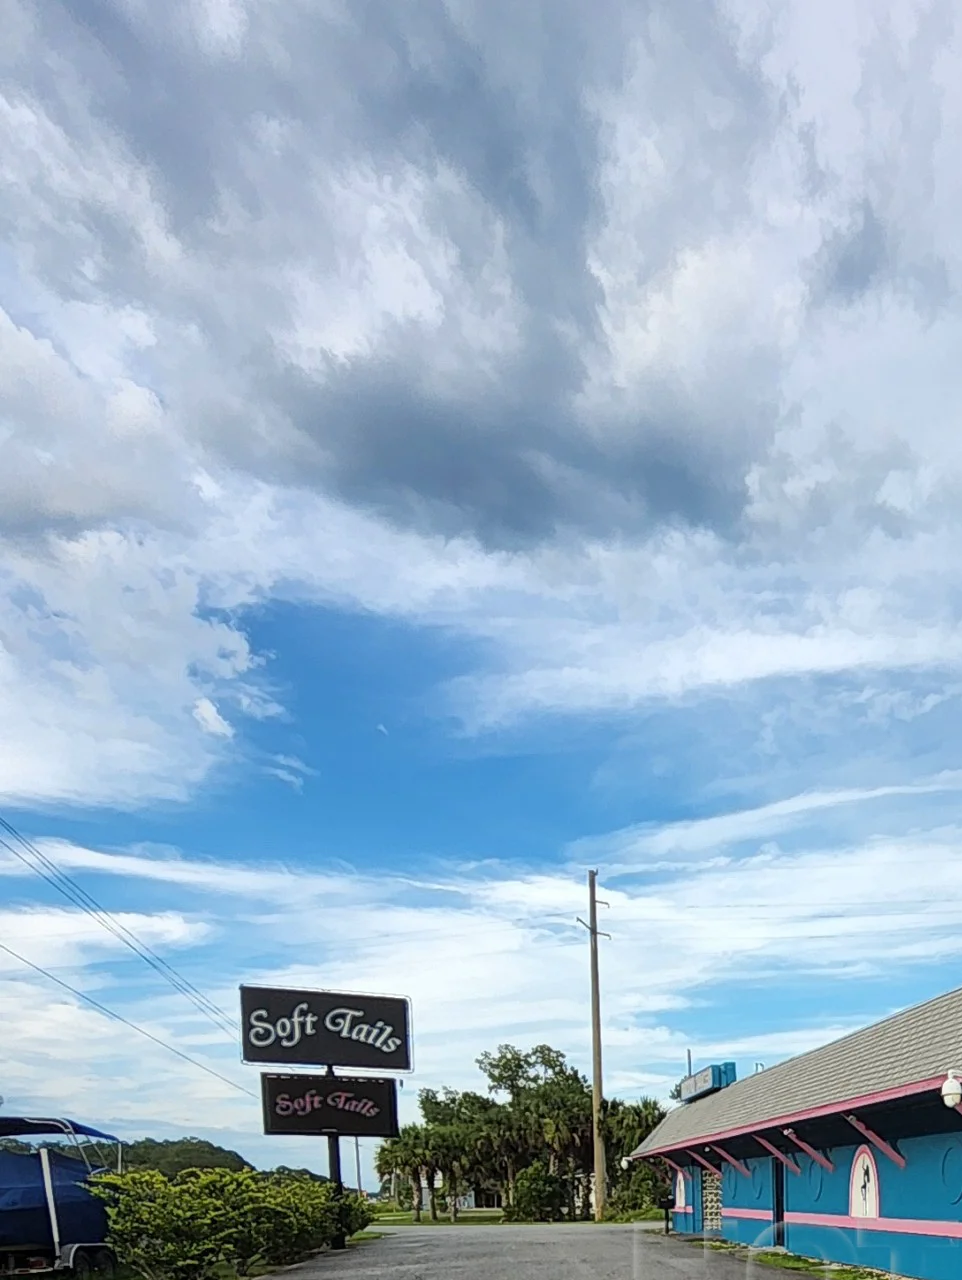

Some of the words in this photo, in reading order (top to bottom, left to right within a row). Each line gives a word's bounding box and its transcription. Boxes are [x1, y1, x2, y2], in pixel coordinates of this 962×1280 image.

[249, 1003, 318, 1047] Soft
[325, 1008, 402, 1053] Tails
[276, 1090, 323, 1116] Soft
[327, 1092, 380, 1117] Tails
